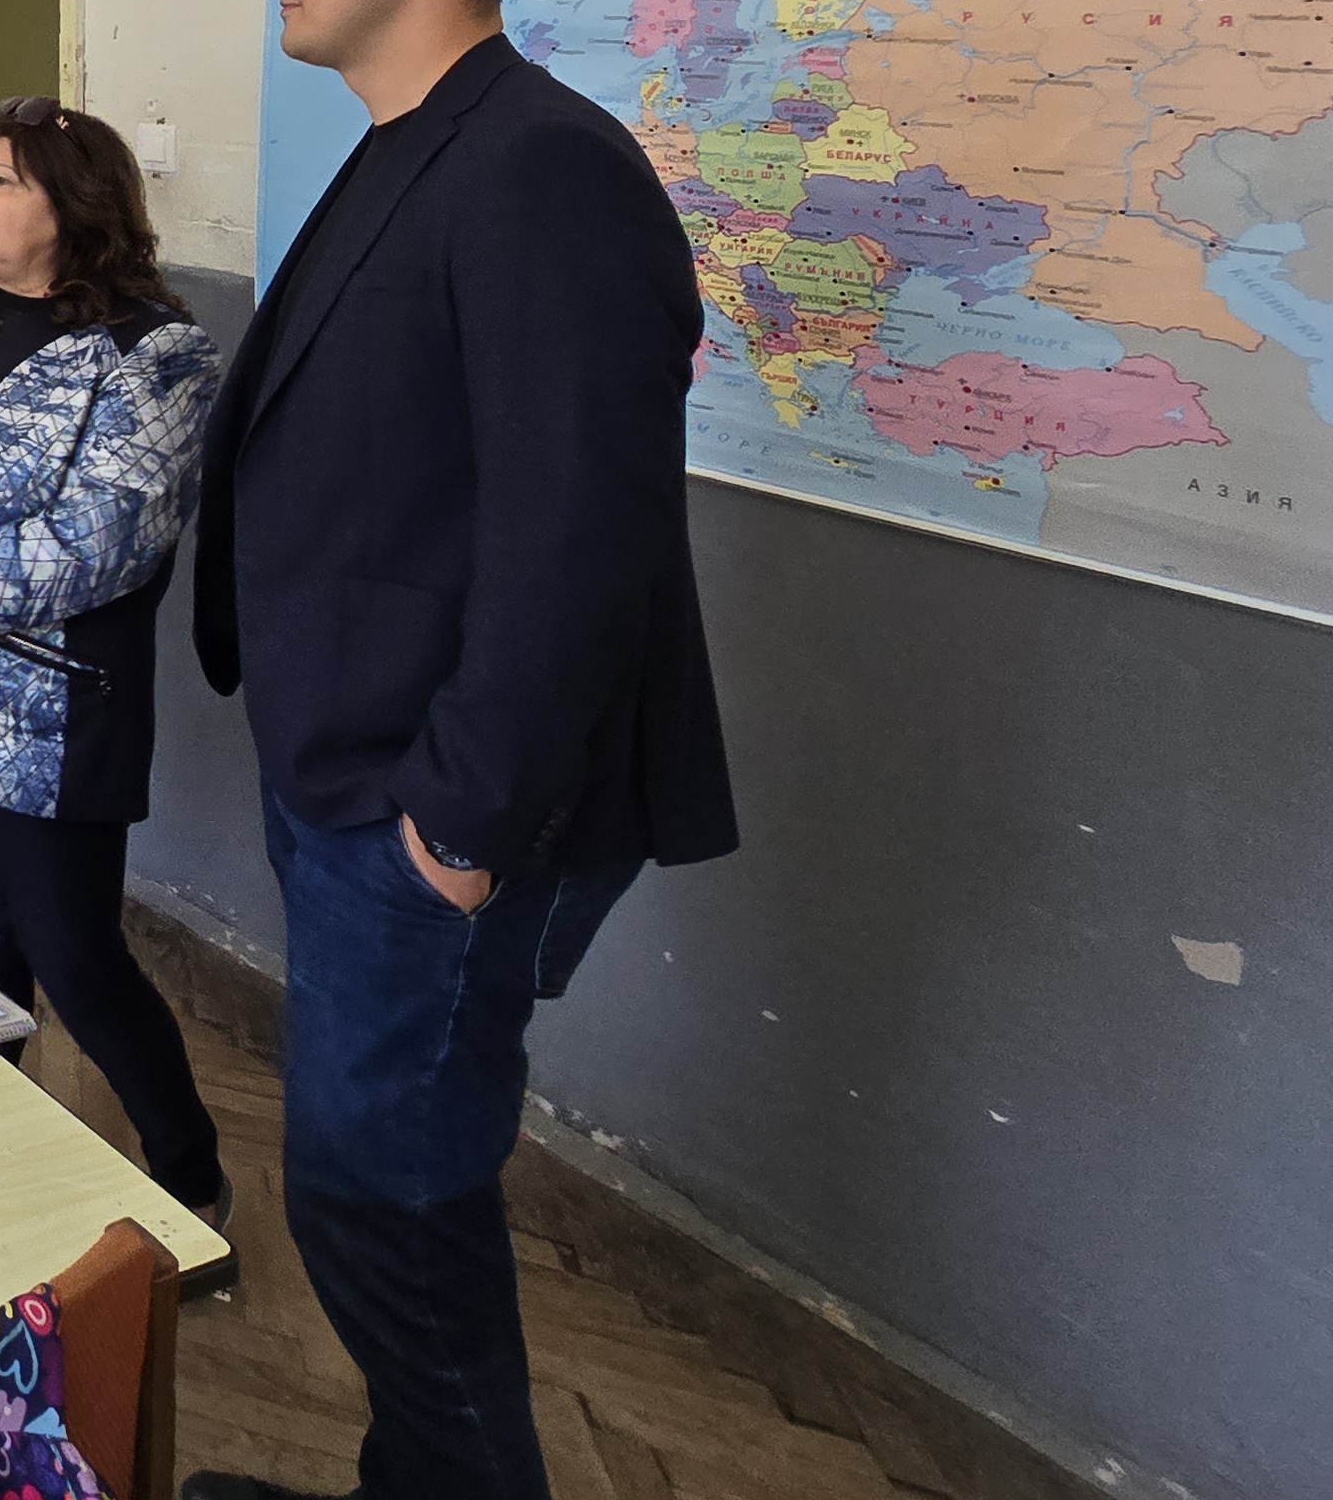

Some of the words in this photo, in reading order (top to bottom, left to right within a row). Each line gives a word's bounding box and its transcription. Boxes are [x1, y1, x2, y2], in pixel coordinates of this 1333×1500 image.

[962, 11, 1234, 28] РУСИЯ
[826, 149, 893, 164] БЕЛАРУС
[717, 166, 786, 181] ПОЛША
[719, 241, 774, 255] УНГАРИЯ
[784, 262, 866, 281] РУМЪНИЯ
[812, 316, 872, 332] БЪЛГАРИЯ
[935, 321, 1003, 340] ЧЕРНО
[1014, 334, 1071, 351] МОРЕ
[909, 394, 1066, 432] ТУРЦИЯ
[1187, 478, 1293, 512] АЗИЯ
